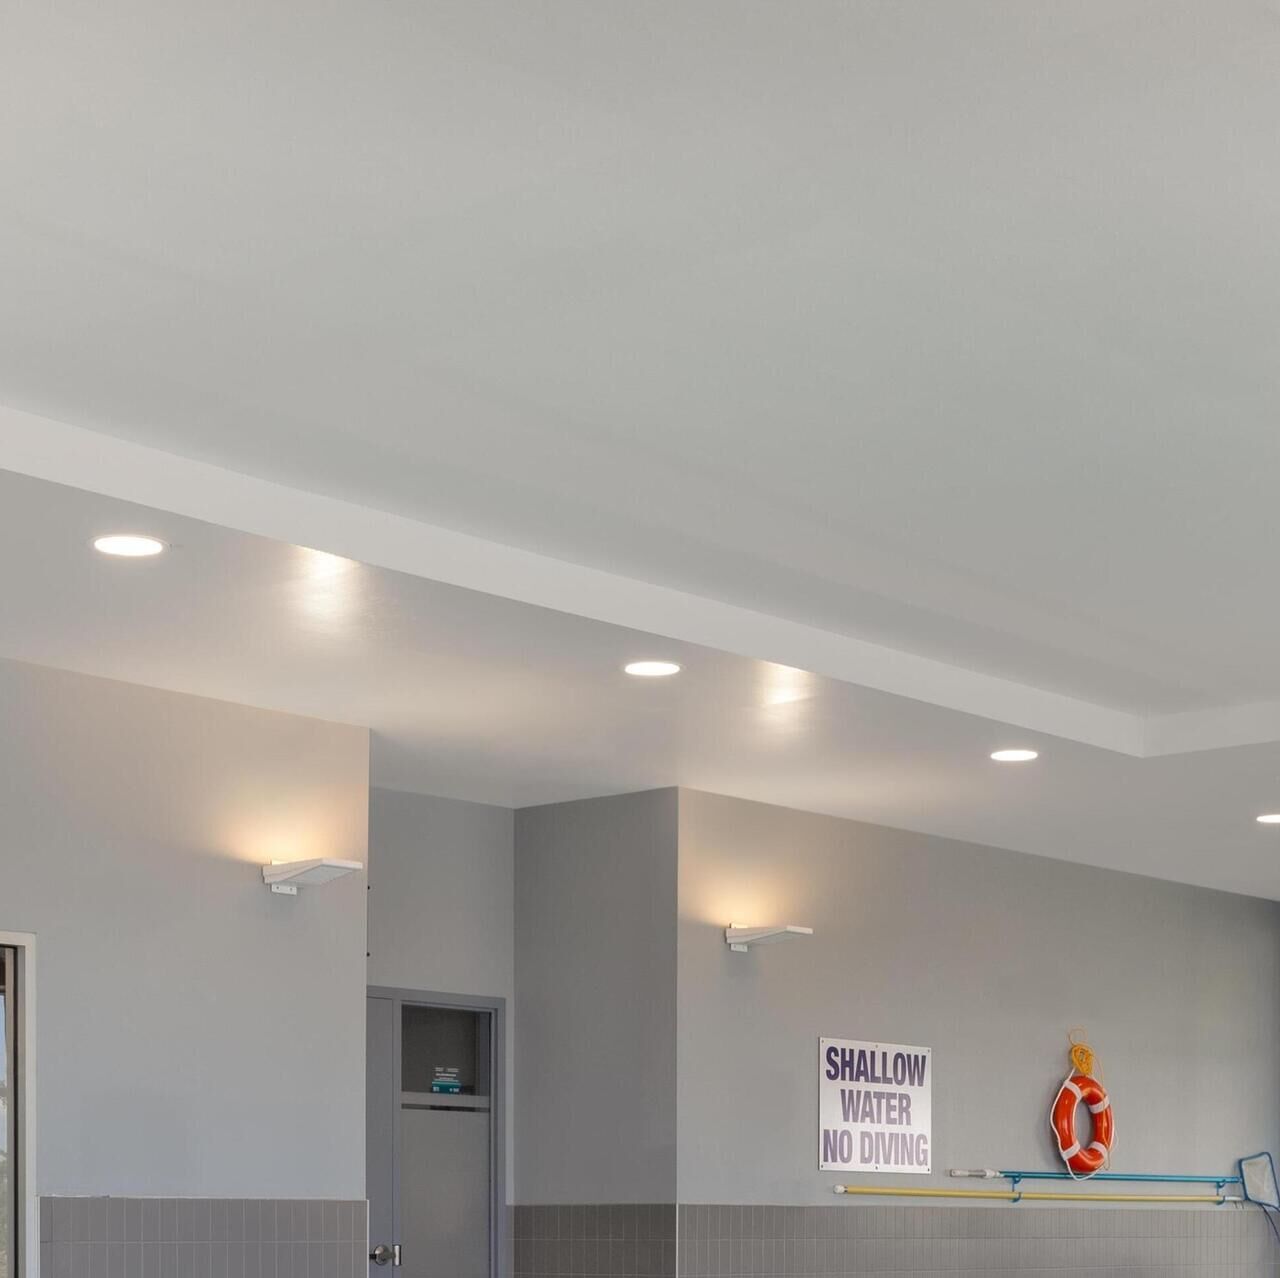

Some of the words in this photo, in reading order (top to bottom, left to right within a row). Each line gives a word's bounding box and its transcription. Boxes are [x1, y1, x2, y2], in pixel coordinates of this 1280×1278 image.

[826, 1046, 926, 1087] SHALLOW
[840, 1089, 911, 1126] WATER
[823, 1129, 852, 1164] NO
[860, 1131, 928, 1166] DIVING
